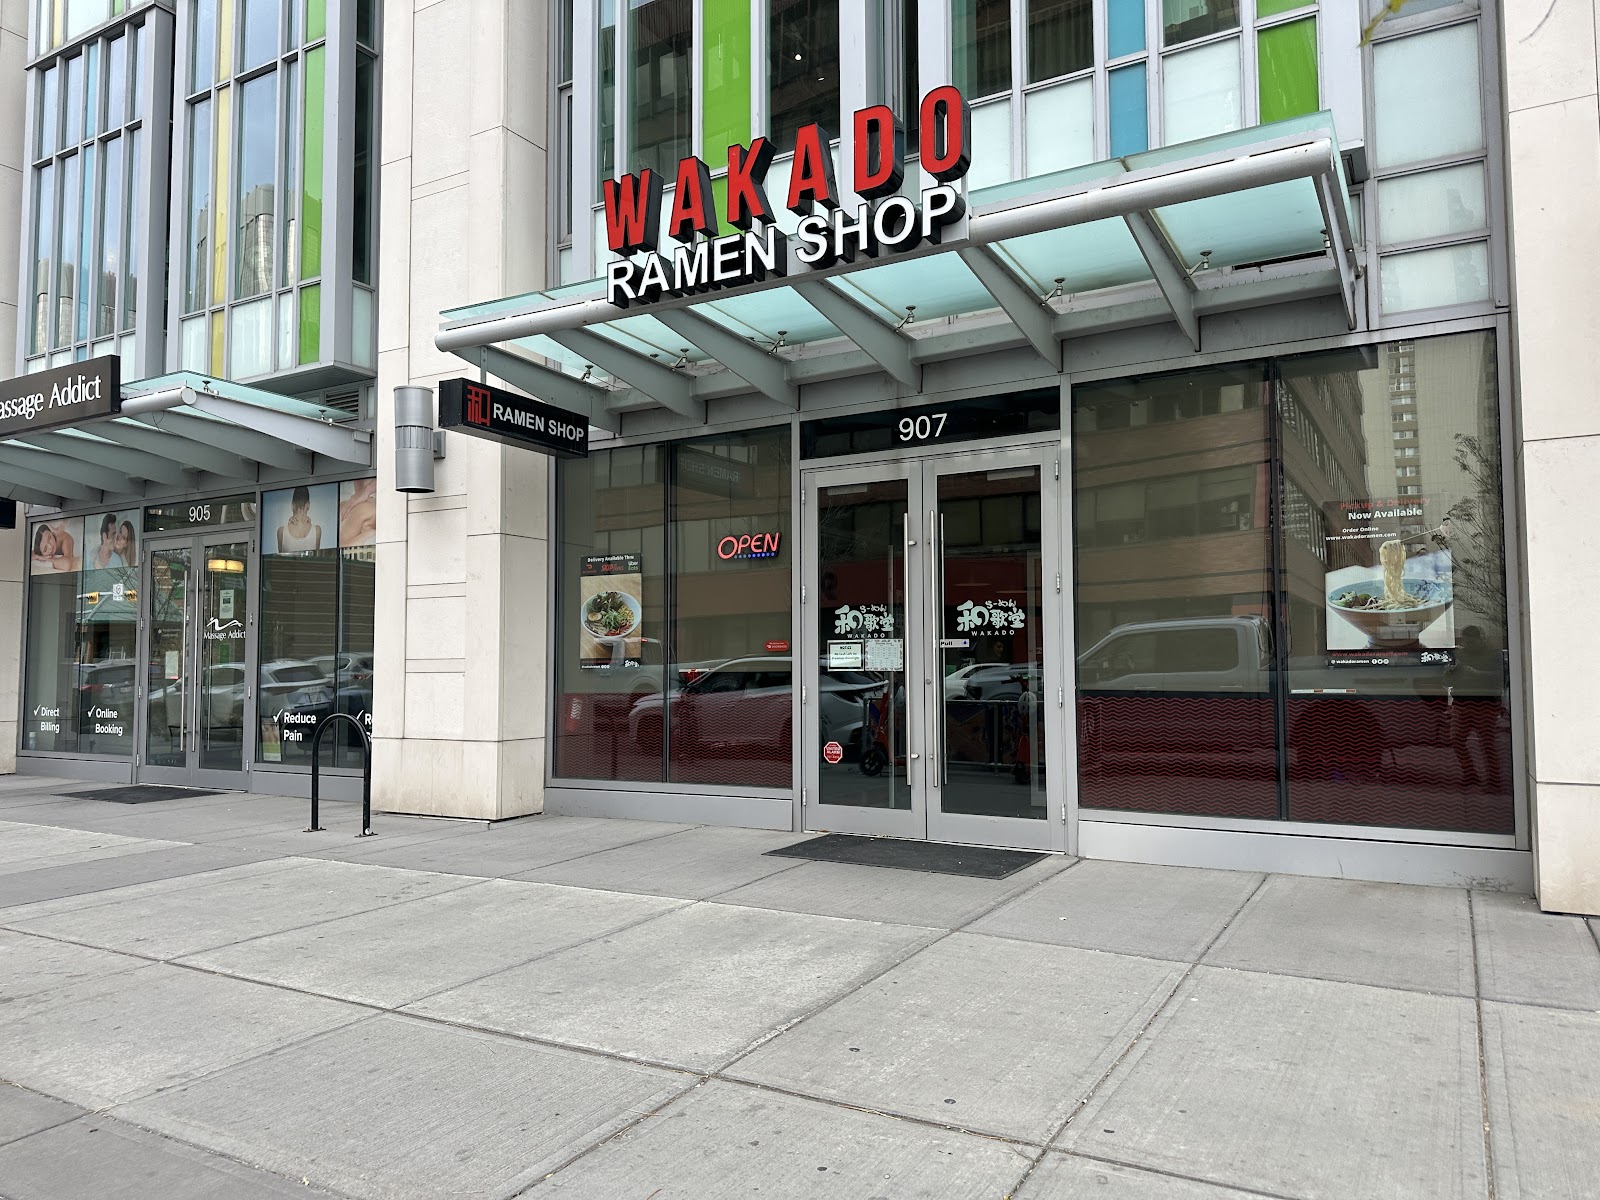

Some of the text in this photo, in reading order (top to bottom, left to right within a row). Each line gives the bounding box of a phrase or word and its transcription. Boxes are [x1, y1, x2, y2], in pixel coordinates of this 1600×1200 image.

[603, 85, 967, 254] WAKADO
[607, 185, 960, 303] RAMEN SHOP
[48, 375, 101, 409] Addict
[493, 402, 585, 442] RAMEN SHOP
[899, 413, 948, 441] 907
[1340, 502, 1374, 510] Pickup
[1387, 498, 1430, 506] Delivery
[189, 504, 211, 522] 905
[1348, 508, 1423, 520] Now Available
[1325, 532, 1397, 541] www.wakadoramen.com
[717, 532, 779, 560] OPEN
[204, 629, 246, 641] Massage Addict
[971, 629, 1015, 637] WAKADO
[41, 707, 60, 717] Direct
[95, 708, 118, 719] Online
[284, 712, 317, 724] Reduce
[40, 722, 60, 734] Billing
[95, 723, 123, 736] Booking
[283, 729, 303, 742] Pain
